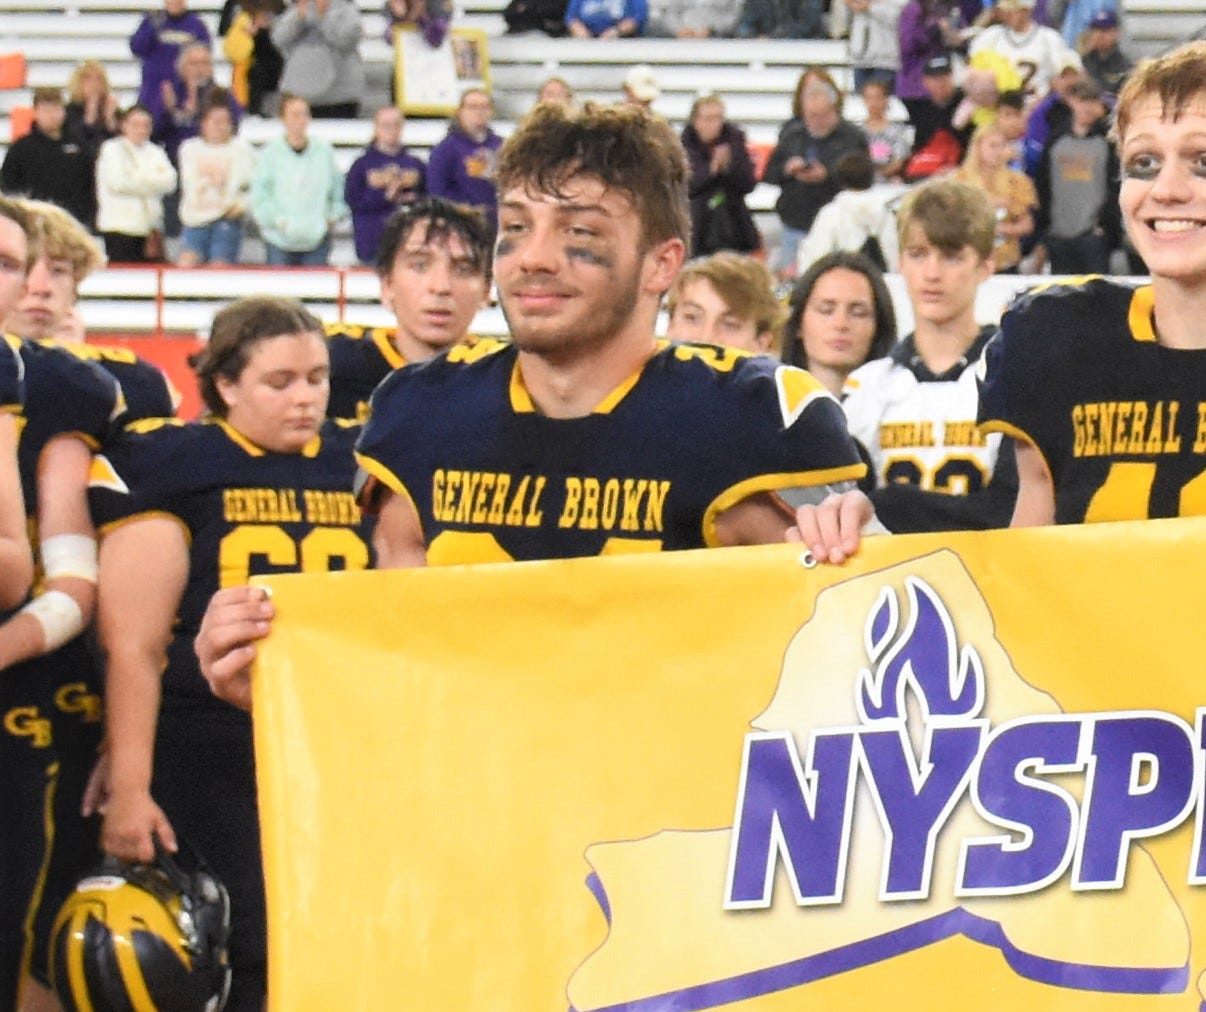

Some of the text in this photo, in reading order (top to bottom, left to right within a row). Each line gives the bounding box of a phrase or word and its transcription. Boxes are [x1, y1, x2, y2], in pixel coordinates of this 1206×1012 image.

[1071, 401, 1182, 458] GENERAL
[223, 488, 302, 523] GENERAL
[433, 469, 671, 532] GENERAL BROWN
